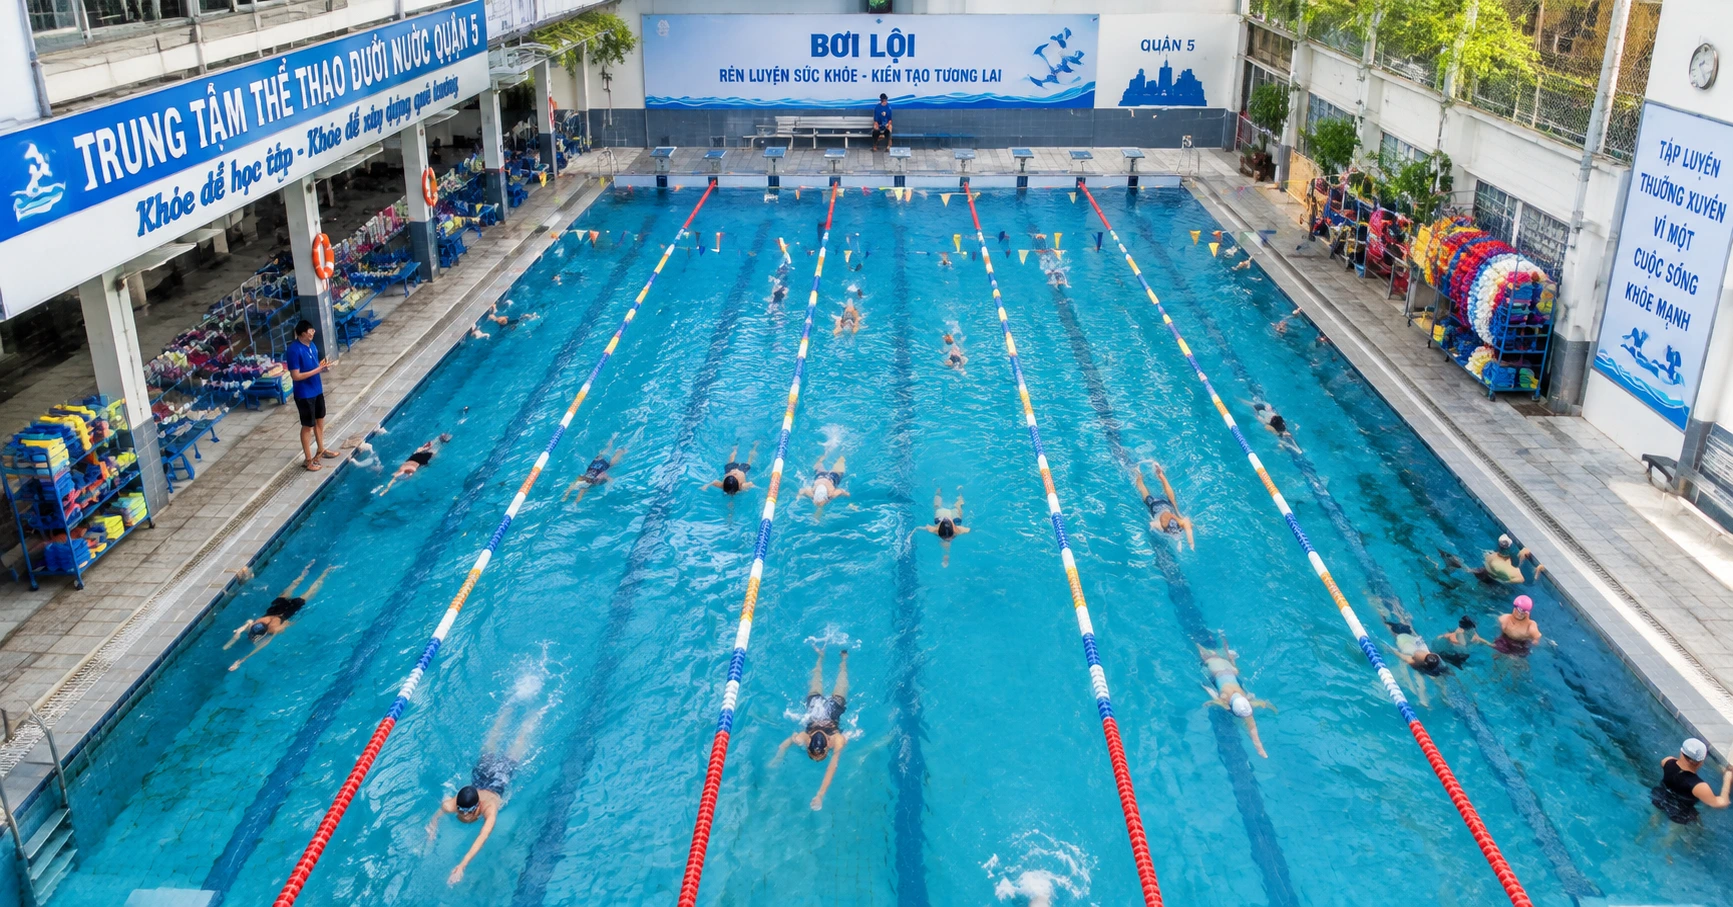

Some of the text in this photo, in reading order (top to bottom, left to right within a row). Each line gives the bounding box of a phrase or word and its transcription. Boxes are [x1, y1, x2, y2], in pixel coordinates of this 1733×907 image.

[810, 27, 916, 64] BƠI LỘI
[1187, 39, 1196, 52] 5
[905, 69, 930, 87] TẠO
[934, 67, 978, 83] TƯƠNG
[982, 69, 1002, 83] LAI
[73, 107, 187, 191] TRUNG
[249, 57, 294, 127] THỂ
[470, 13, 479, 46] 5
[231, 158, 262, 195] học
[1634, 247, 1664, 279] CUỘC
[1655, 297, 1691, 332] MẠNH
